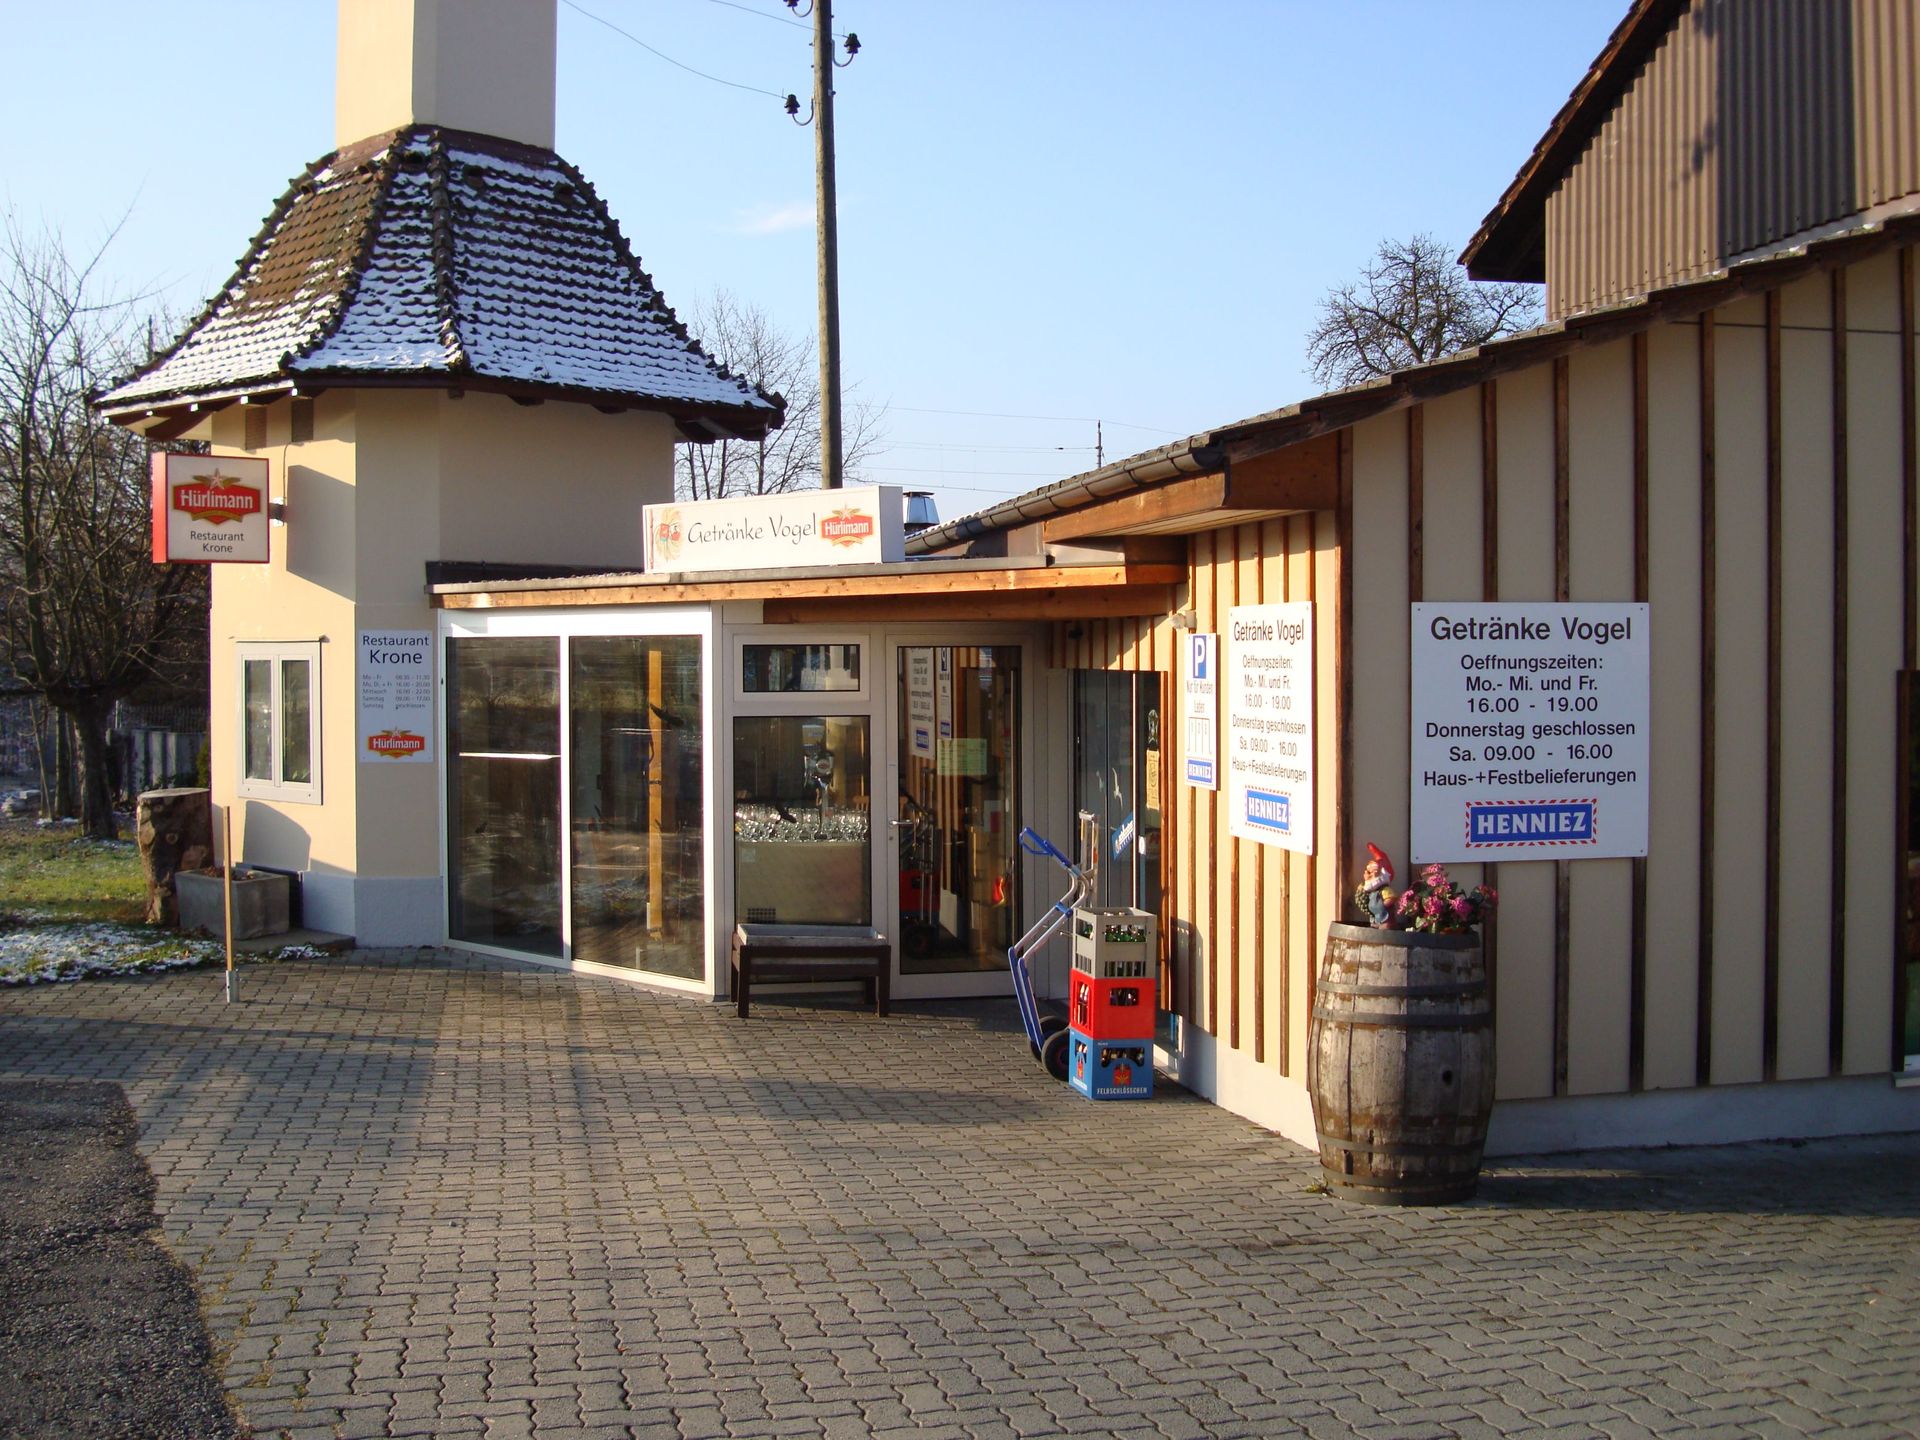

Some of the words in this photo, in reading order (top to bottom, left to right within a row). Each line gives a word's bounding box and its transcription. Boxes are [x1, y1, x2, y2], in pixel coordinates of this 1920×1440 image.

[180, 489, 254, 509] Hürlimann
[190, 530, 245, 542] Restaurant
[688, 517, 765, 544] Getränke
[769, 511, 817, 546] Vogel
[824, 521, 869, 537] Hürlimann
[202, 543, 233, 553] Krone
[1233, 620, 1273, 642] Getränke
[1276, 618, 1305, 646] Vogel
[1430, 616, 1551, 641] Getränke
[1561, 616, 1632, 645] Vogel
[362, 635, 430, 646] Restaurant
[370, 649, 423, 664] Krone
[1194, 637, 1206, 677] P
[1242, 654, 1293, 671] Oeffnungszeiten:
[1460, 654, 1604, 673] Oeffnungszeiten:
[1268, 676, 1281, 689] und
[1508, 675, 1534, 692] Mi.
[1540, 674, 1572, 691] und
[1578, 674, 1599, 692] Fr.
[1244, 693, 1263, 708] 16.00
[1271, 695, 1292, 711] 19.00
[1466, 697, 1520, 713] 16.00
[1547, 696, 1599, 712] 19.00
[1232, 714, 1265, 734] Donnerstag
[1266, 717, 1306, 736] geschlossen
[1425, 722, 1525, 740] Donnerstag
[1532, 720, 1636, 740] geschlossen
[373, 738, 421, 749] Hürlimann
[1250, 737, 1268, 753] 09.00
[1279, 741, 1298, 757] 16.00
[1449, 746, 1477, 762] Sa.
[1483, 745, 1536, 761] 09.00
[1566, 743, 1613, 760] 16.00
[1247, 796, 1289, 824] HENNIEZ
[1476, 811, 1587, 835] HENNIEZ
